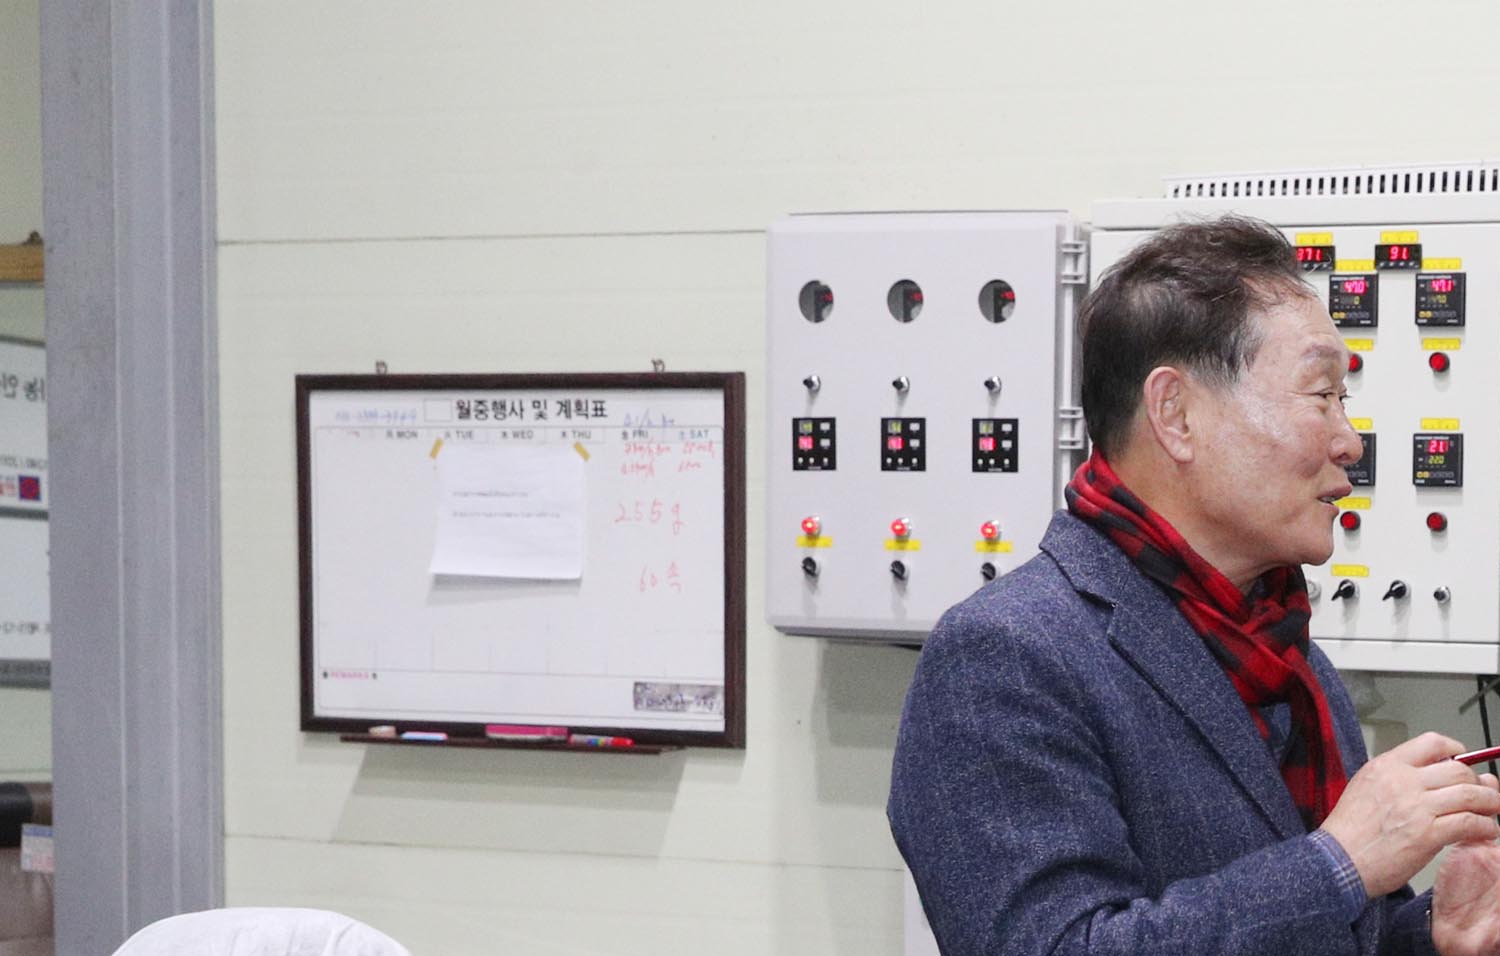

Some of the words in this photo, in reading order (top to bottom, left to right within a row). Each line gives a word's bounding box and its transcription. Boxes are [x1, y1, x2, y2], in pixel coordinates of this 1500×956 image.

[455, 399, 524, 421] 월중행사
[532, 399, 547, 421] 및
[556, 399, 608, 420] 계획표
